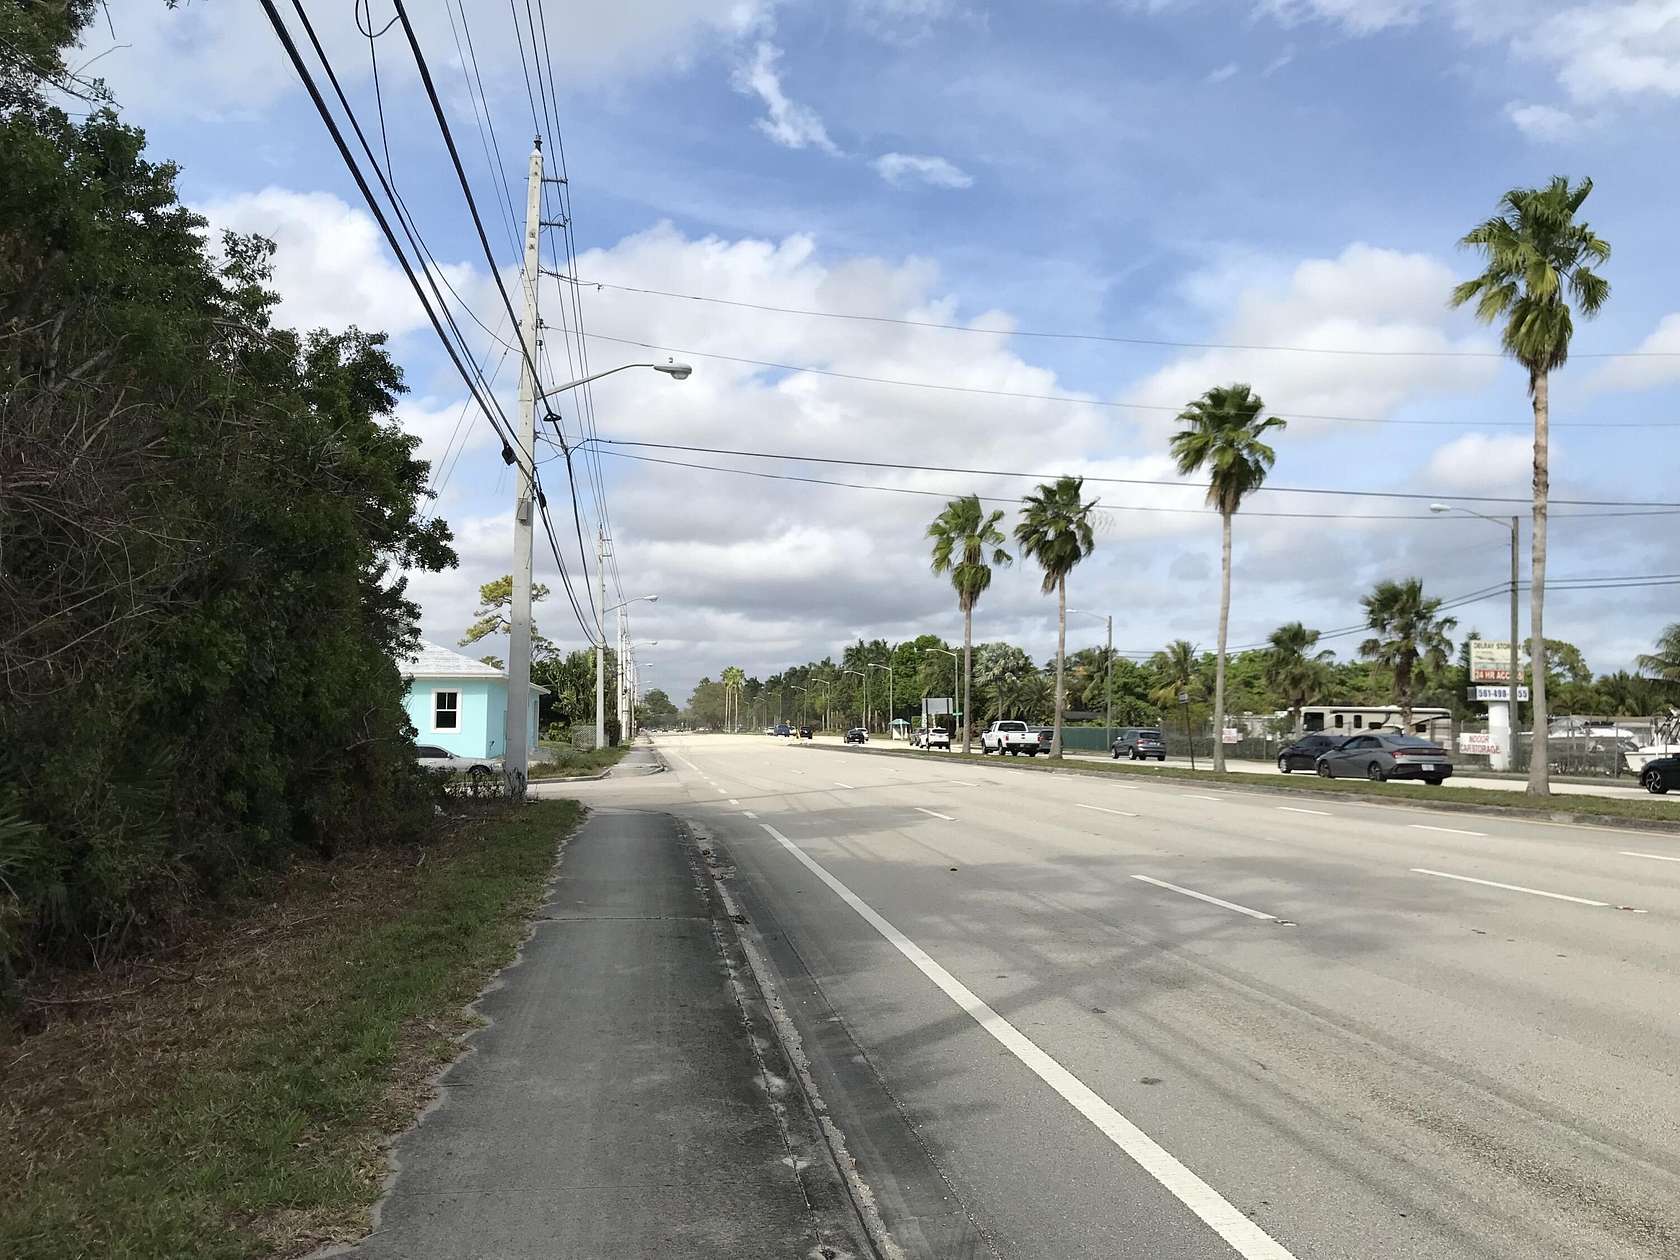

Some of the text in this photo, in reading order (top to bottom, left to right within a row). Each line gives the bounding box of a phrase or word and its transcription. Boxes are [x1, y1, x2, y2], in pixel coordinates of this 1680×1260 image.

[1485, 671, 1495, 680] HR
[1496, 671, 1523, 681] ACCS
[1478, 689, 1527, 698] 561-498-55
